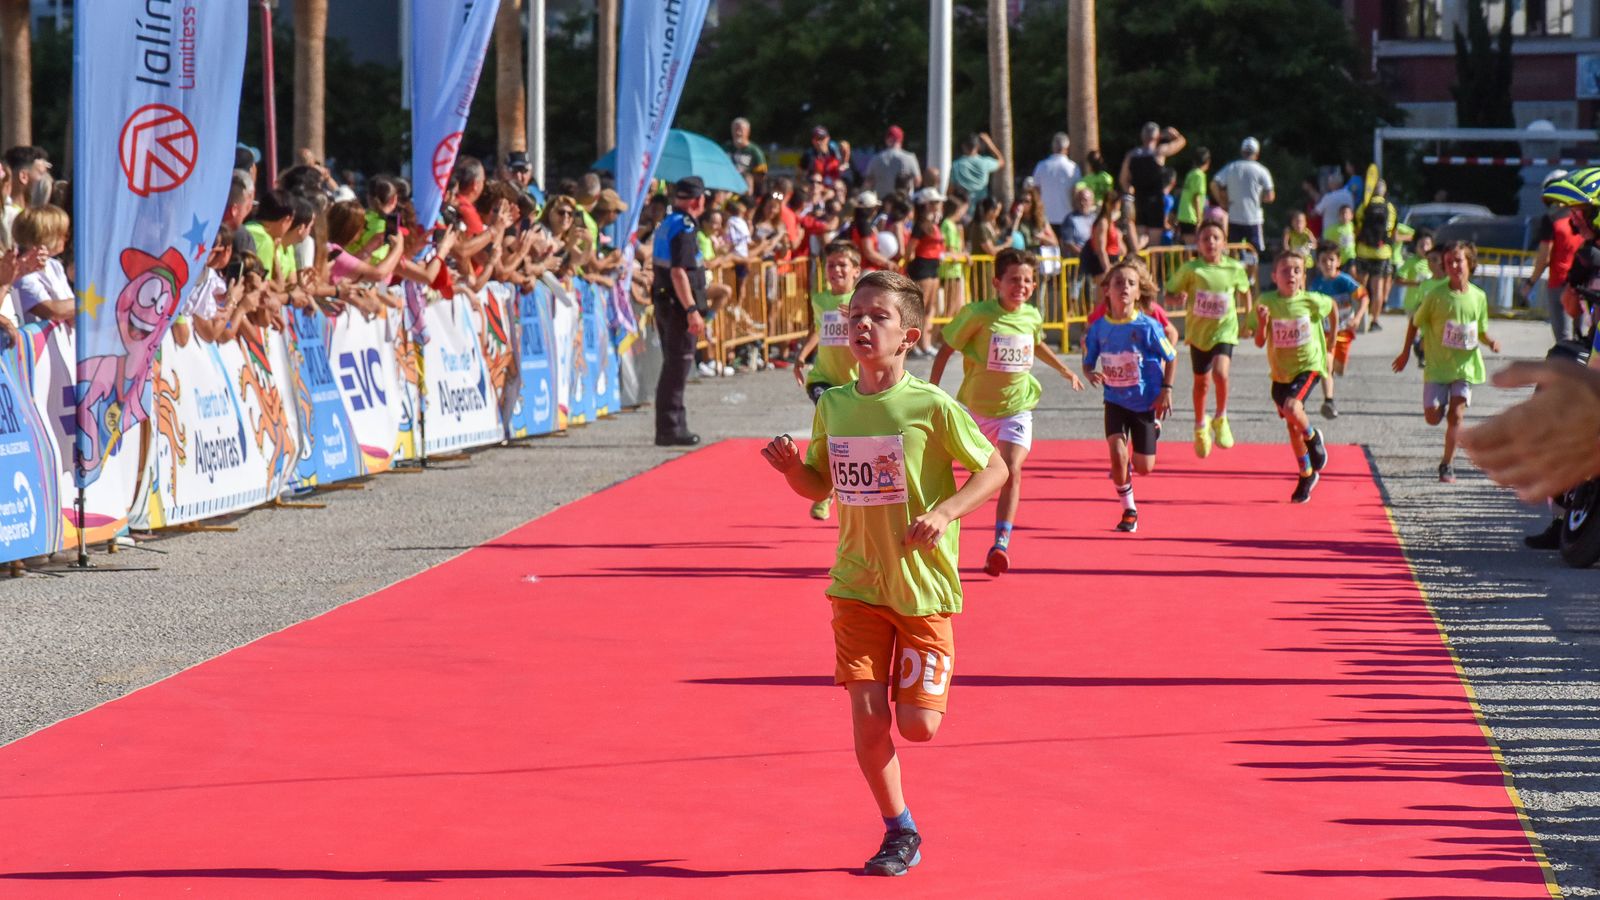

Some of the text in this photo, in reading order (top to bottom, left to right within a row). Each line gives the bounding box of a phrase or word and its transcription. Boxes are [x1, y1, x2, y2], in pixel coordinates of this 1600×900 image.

[178, 6, 196, 90] Limitless
[994, 347, 1022, 362] 1233
[194, 425, 240, 485] Algeciras
[832, 460, 873, 487] 1550
